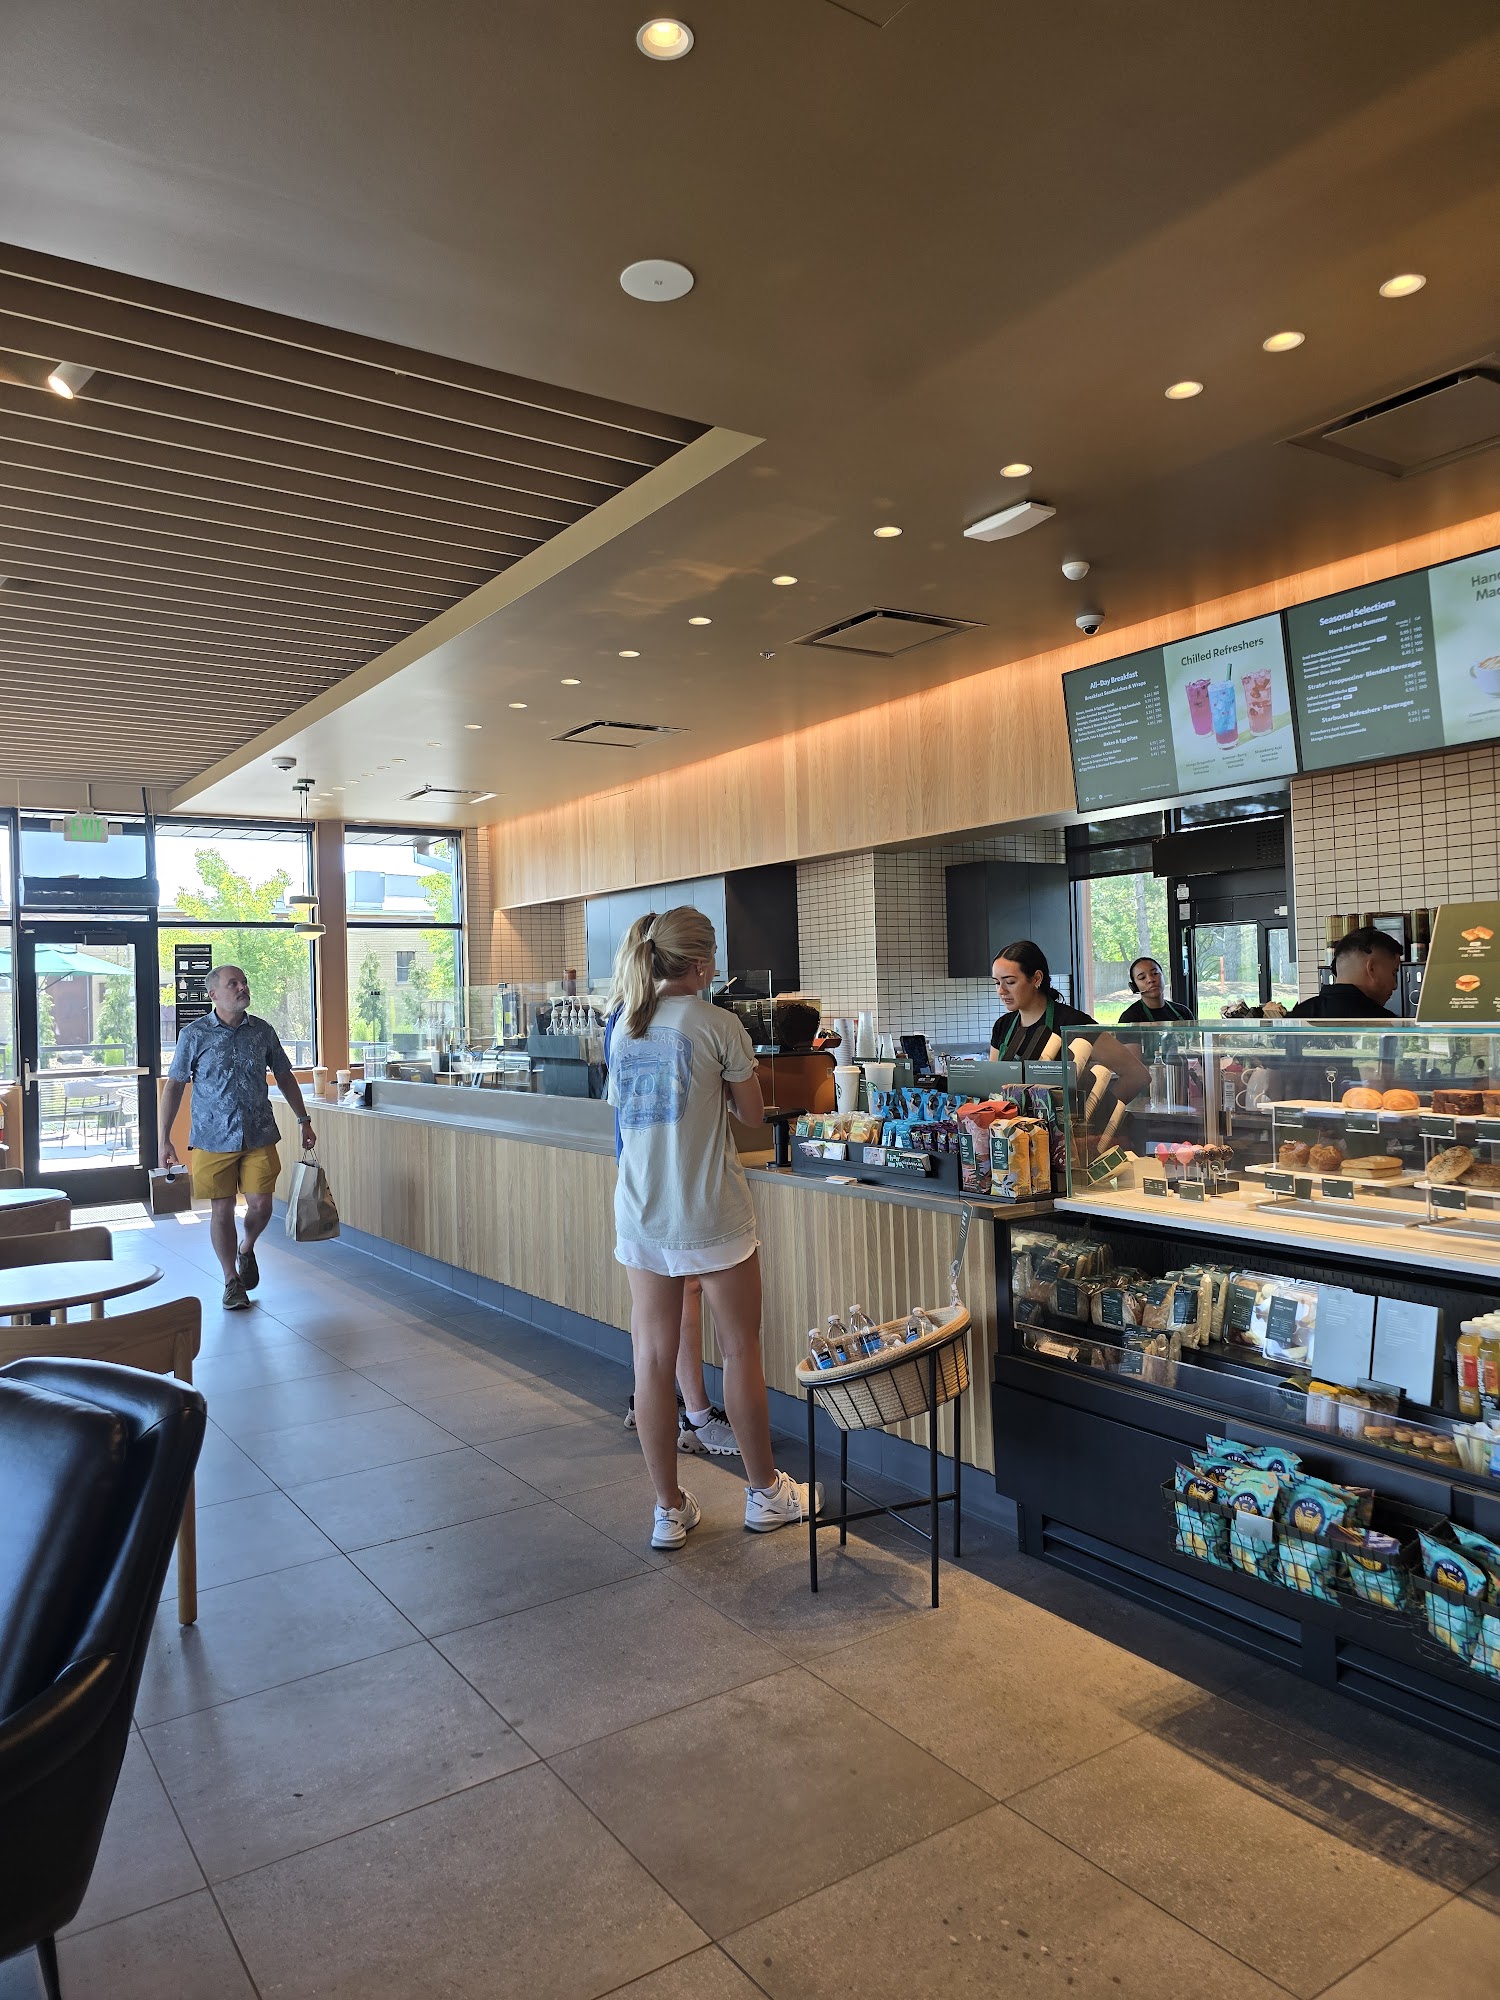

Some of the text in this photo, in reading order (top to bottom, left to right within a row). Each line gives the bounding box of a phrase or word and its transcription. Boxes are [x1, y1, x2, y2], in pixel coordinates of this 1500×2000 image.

[1319, 600, 1396, 626] Seasonal Selections
[1328, 628, 1342, 636] Here
[1362, 616, 1388, 627] Summer
[1181, 638, 1264, 666] Chilled Refreshers
[1365, 668, 1390, 678] Blended
[1390, 660, 1422, 672] Beverages
[1090, 672, 1138, 690] All-Day Breakfast
[1322, 713, 1349, 724] Starbucks
[1383, 700, 1414, 711] Beverages
[72, 817, 101, 840] EXIT
[1238, 1496, 1254, 1504] SIETE
[1301, 1502, 1320, 1512] SIETE
[1442, 1562, 1462, 1578] SIETE
